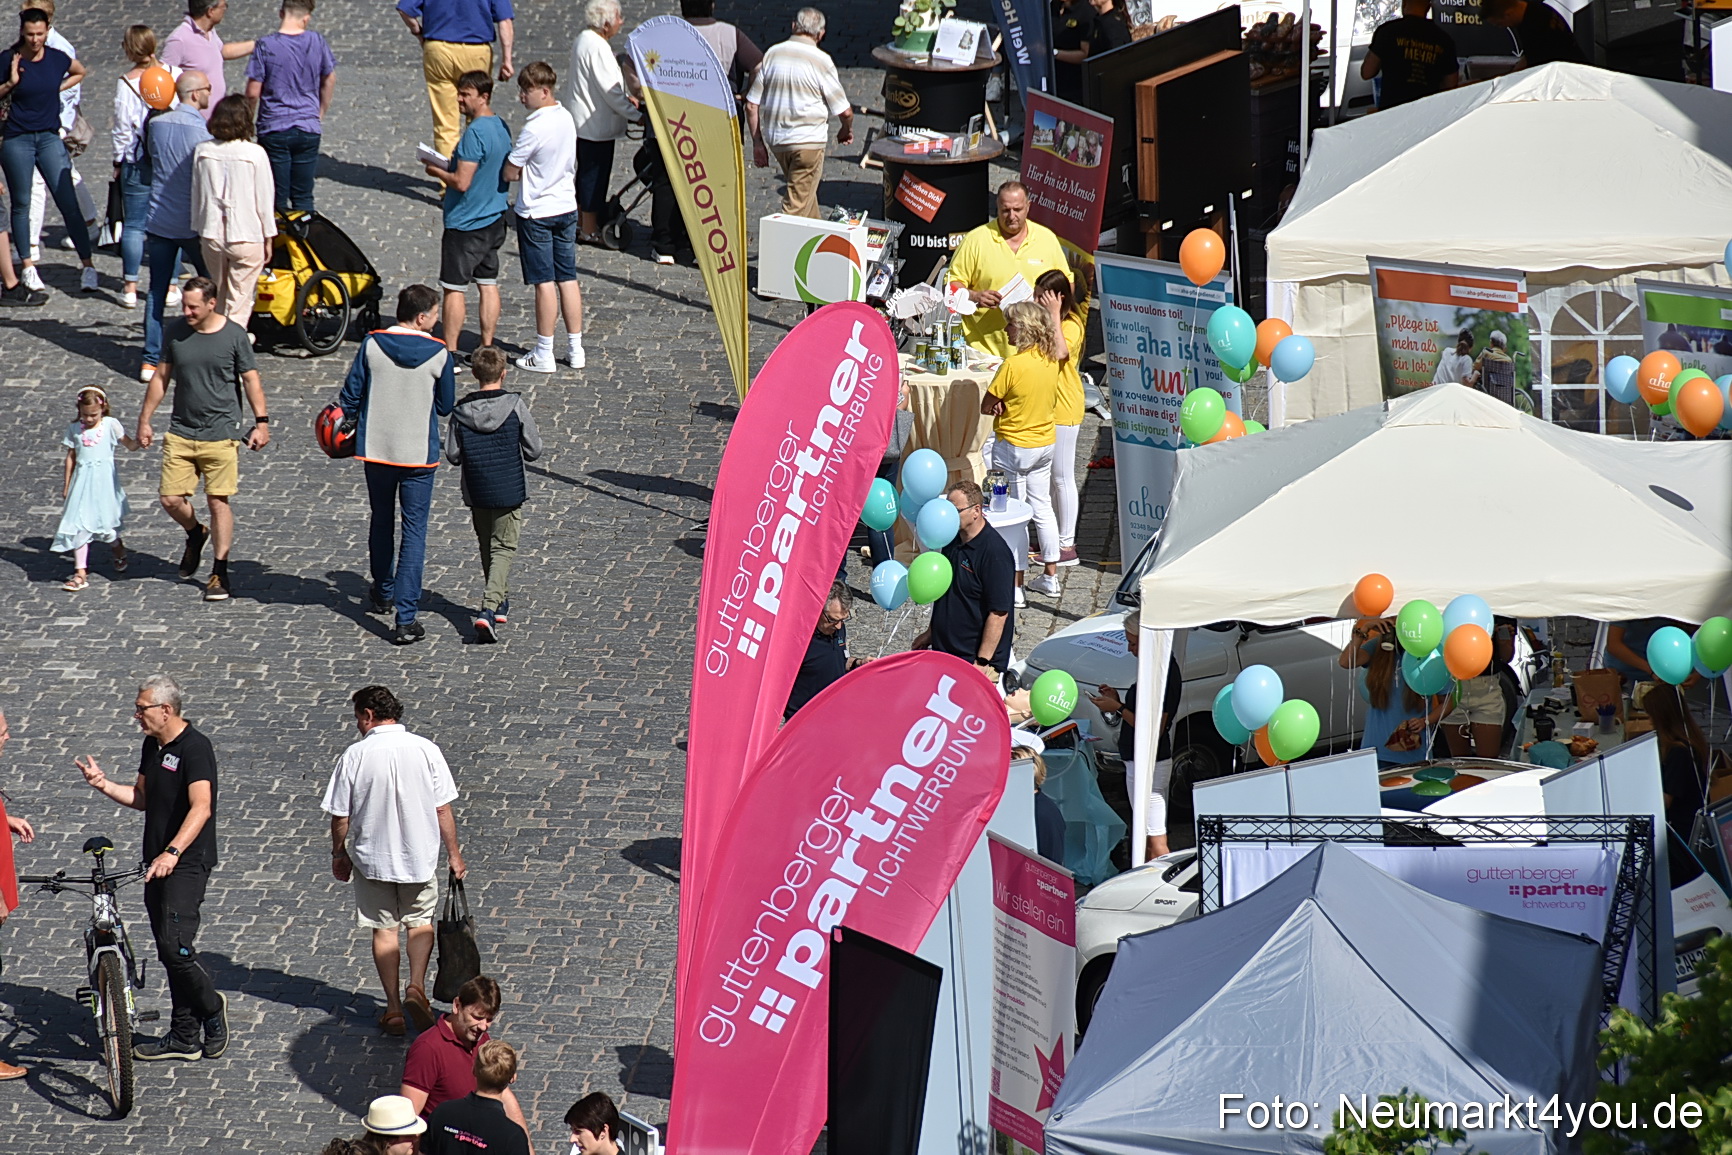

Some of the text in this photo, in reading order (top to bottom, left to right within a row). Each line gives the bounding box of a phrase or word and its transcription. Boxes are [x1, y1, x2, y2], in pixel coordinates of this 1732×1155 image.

[1440, 11, 1483, 25] Ihr Brot.
[1287, 140, 1300, 154] Hie
[1285, 159, 1297, 173] für
[1026, 163, 1096, 203] Hier bin ich Mensch
[1027, 185, 1087, 222] ier kann ich sein!
[910, 234, 966, 248] DU bist GO
[1109, 300, 1183, 320] Nous voulons toi!
[1105, 317, 1151, 334] Wir wollen
[1177, 321, 1208, 335] Chcem
[1425, 319, 1439, 333] ist
[1107, 331, 1128, 345] Dich!
[1136, 332, 1200, 362] aha ist
[1391, 336, 1438, 353] mehr als
[1109, 352, 1141, 369] Chcemy
[1393, 357, 1409, 370] ein
[1110, 368, 1125, 381] Cię!
[1205, 370, 1223, 381] you!
[1394, 376, 1418, 387] Danke
[1649, 372, 1672, 389] aha
[1111, 388, 1184, 408] ми хочемо тебе
[1116, 402, 1177, 424] Vi vil have dig!
[1113, 417, 1129, 430] Seni
[1131, 420, 1168, 437] istiyoruz!
[804, 352, 884, 527] LICHTWERBUNG
[753, 319, 869, 617] partner
[1128, 485, 1168, 520] aha
[705, 418, 801, 678] guttenberger
[1401, 621, 1422, 639] ha!
[1048, 690, 1076, 711] aha!
[866, 713, 986, 897] LICHTWERBUNG
[775, 674, 964, 991] partner
[1466, 866, 1579, 884] guttenberger
[1039, 880, 1069, 900] partner
[1522, 882, 1608, 898] partner
[699, 775, 855, 1047] guttenberger
[995, 879, 1068, 936] Wir stellen ein.
[1522, 900, 1586, 911] lichtwerbung
[459, 1134, 488, 1149] partner
